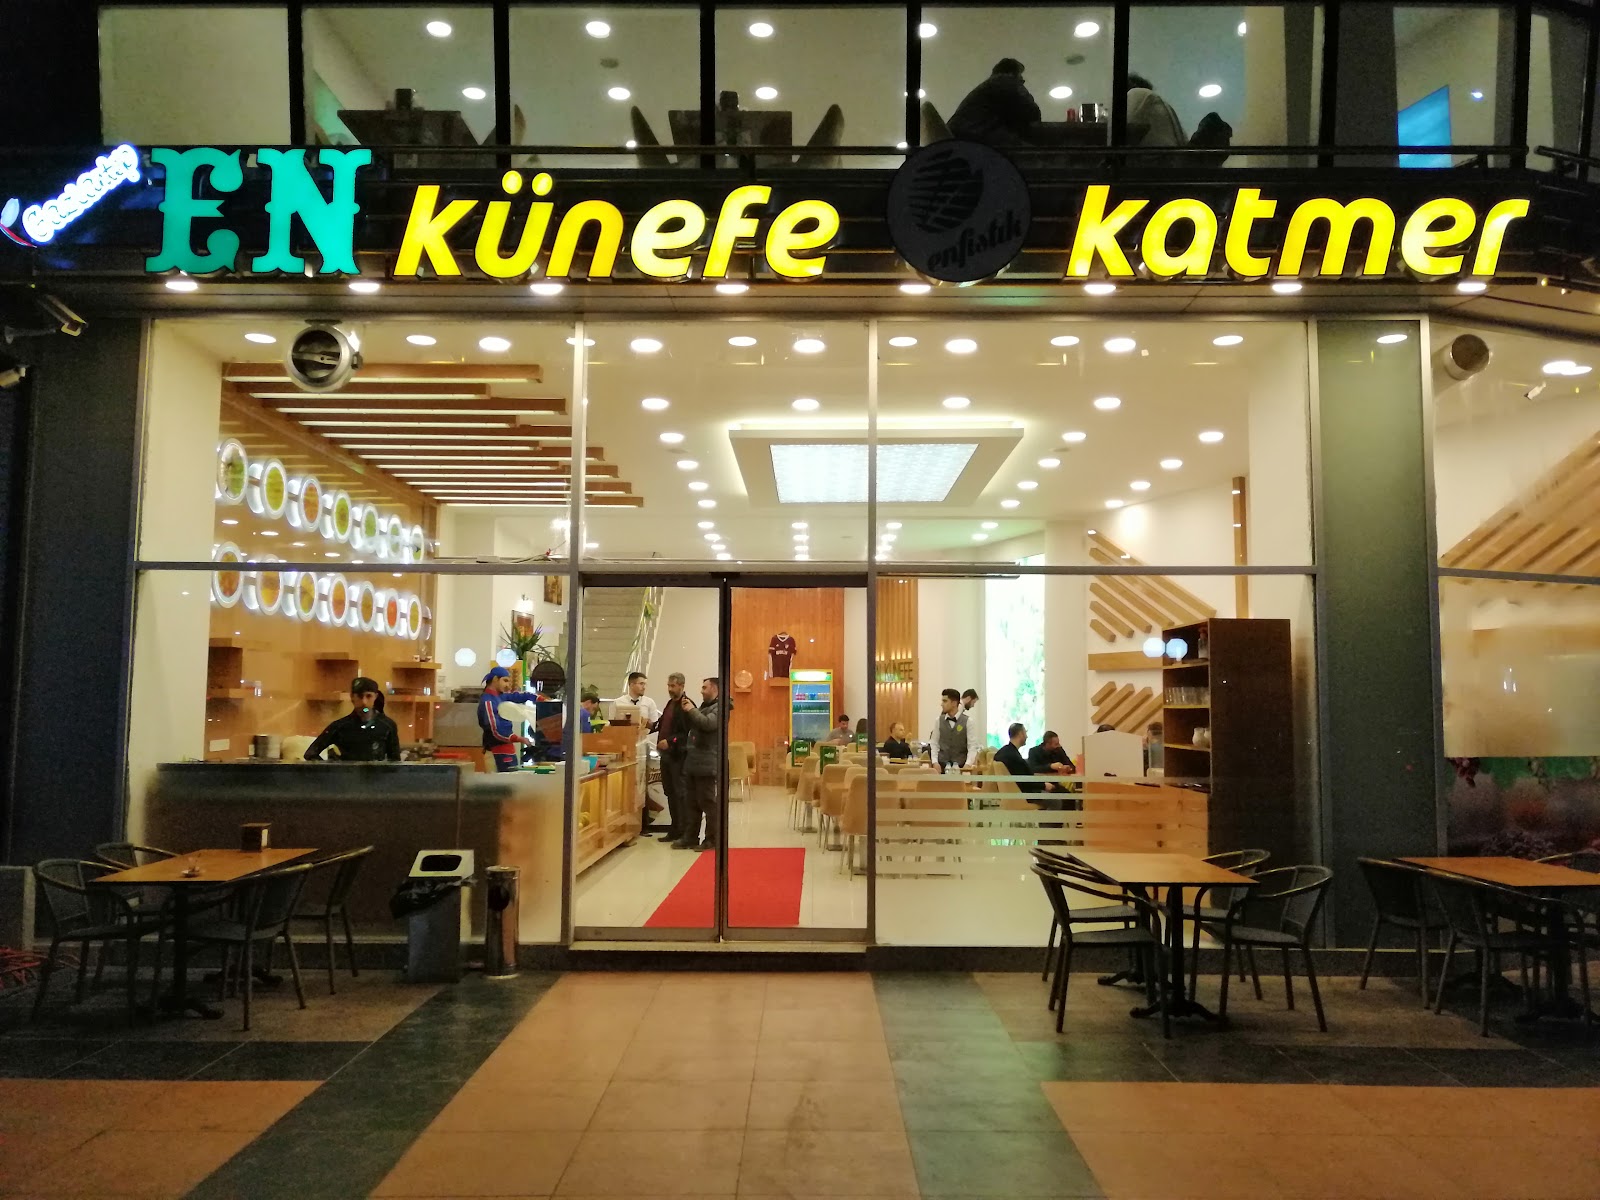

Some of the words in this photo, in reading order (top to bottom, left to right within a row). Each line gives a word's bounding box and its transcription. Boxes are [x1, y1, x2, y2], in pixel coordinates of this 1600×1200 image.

[146, 148, 372, 275] EN
[393, 171, 840, 278] künefe
[1066, 185, 1531, 277] katmer
